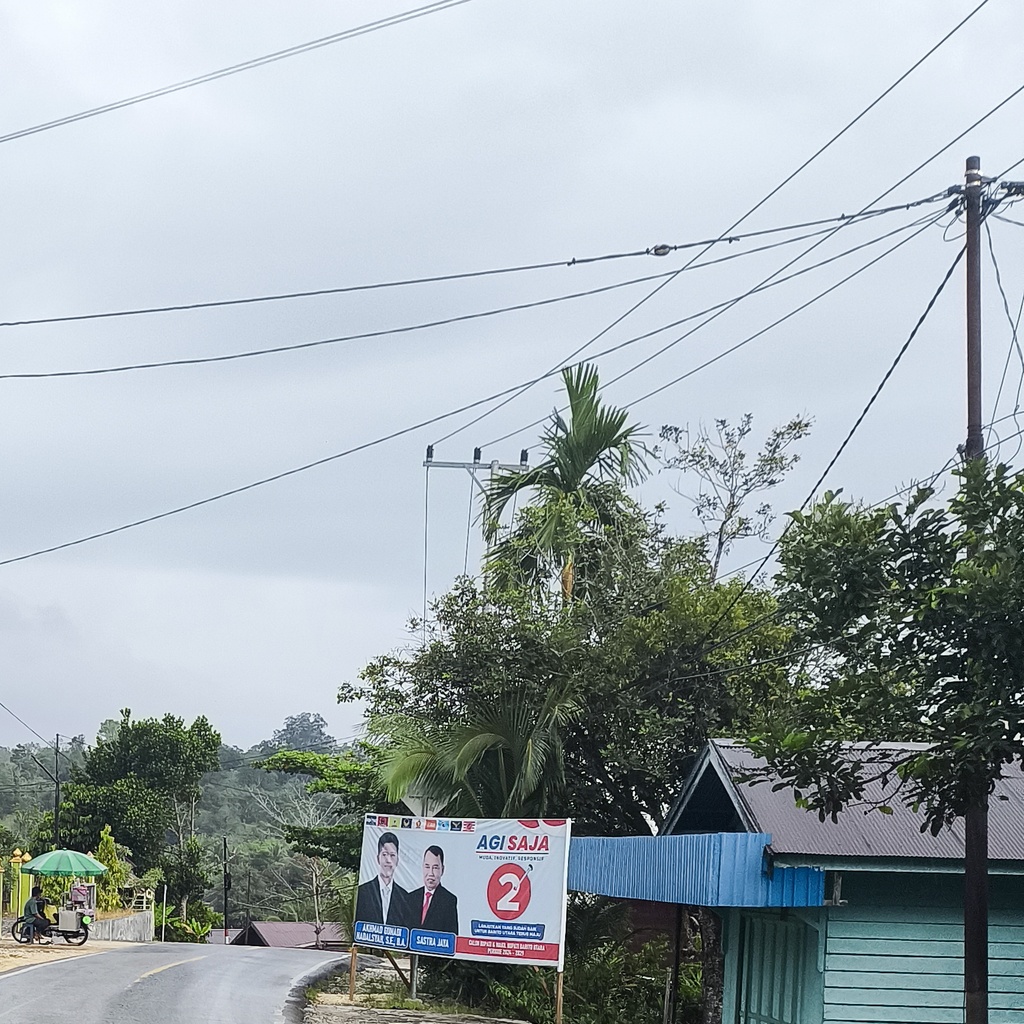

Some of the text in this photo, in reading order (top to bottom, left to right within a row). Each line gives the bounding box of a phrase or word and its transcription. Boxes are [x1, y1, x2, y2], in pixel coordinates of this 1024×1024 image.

[476, 834, 549, 851] AGI SAJA
[496, 872, 520, 911] 2
[416, 935, 449, 948] SASTRA JAYA
